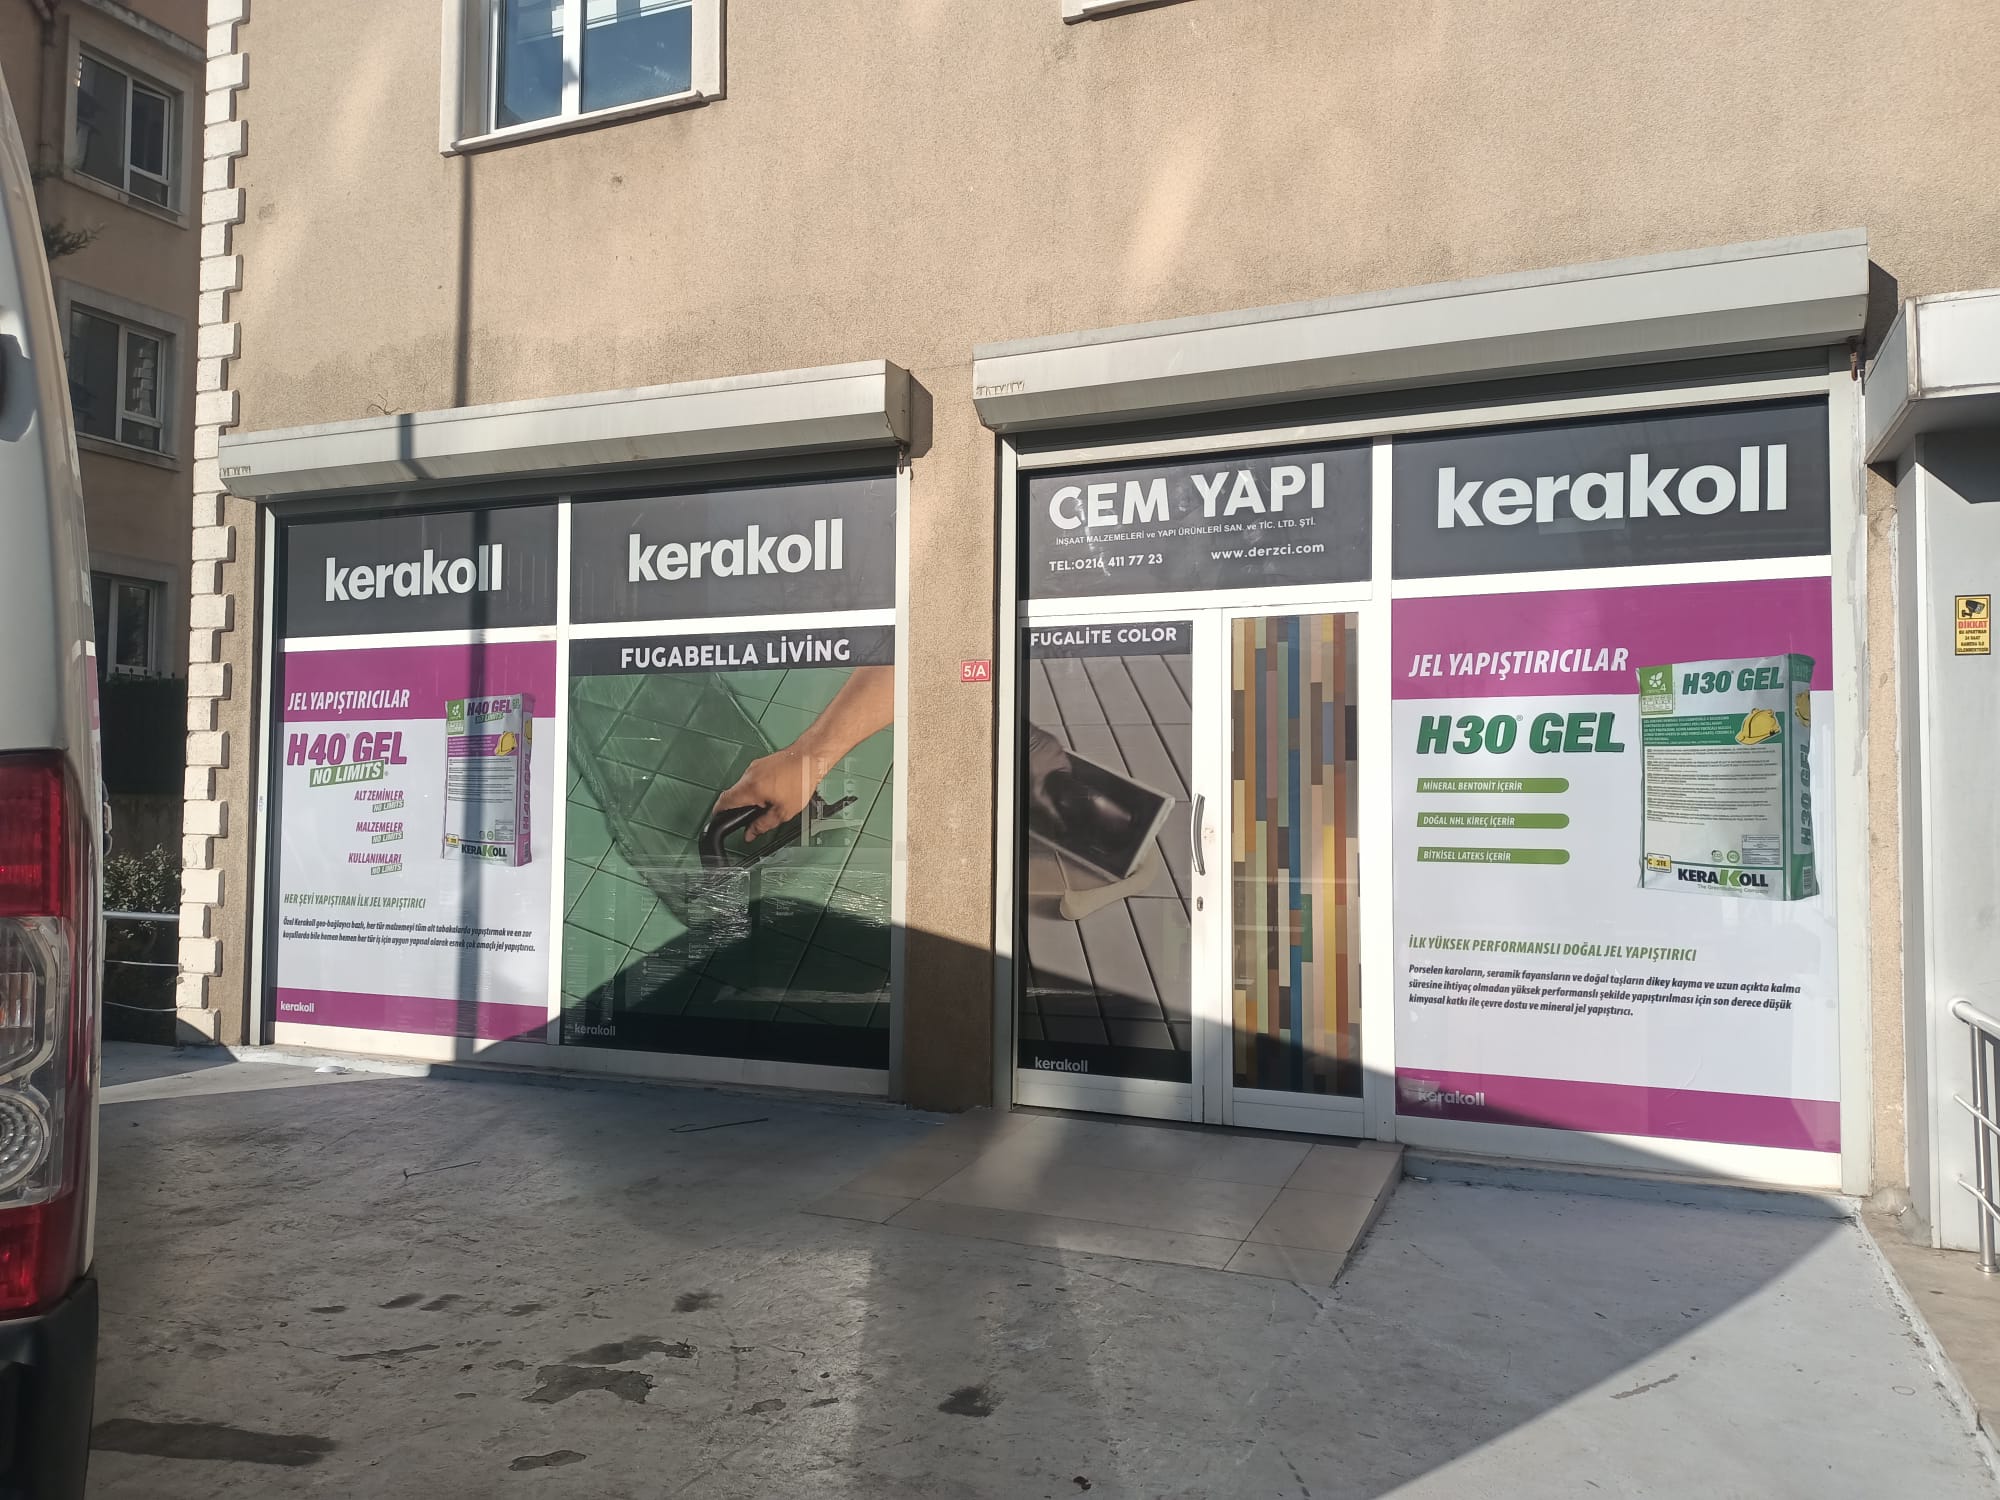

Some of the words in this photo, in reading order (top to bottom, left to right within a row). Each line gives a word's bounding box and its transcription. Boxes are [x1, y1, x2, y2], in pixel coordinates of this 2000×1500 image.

[1437, 443, 1787, 529] kerakoll
[1048, 478, 1170, 530] CEM
[1190, 462, 1325, 518] YAPI
[1056, 536, 1084, 546] İNŞAAT
[1086, 530, 1145, 543] MALZEMELERİ
[1157, 529, 1176, 538] YAPI
[1178, 524, 1222, 536] ÜRÜNLERİ
[1260, 520, 1276, 529] TİC.
[1277, 519, 1297, 528] LTD.
[1299, 516, 1316, 528] ŞTİ.
[628, 518, 843, 582] kerakoll
[1211, 543, 1325, 560] www.derzci.com
[1108, 556, 1125, 567] 411
[1128, 555, 1144, 566] 77
[1148, 553, 1163, 565] 23
[325, 543, 503, 602] kerakoll
[1030, 627, 1112, 647] FUGALİTE
[1117, 627, 1177, 643] COLOR
[621, 643, 759, 669] FUGABELLA
[767, 635, 850, 664] LİVİNG
[964, 665, 986, 678] 5/A
[1408, 654, 1443, 678] JEL
[1449, 647, 1629, 681] YAPIŞTIRICILAR
[1682, 670, 1732, 695] H30
[1737, 666, 1785, 691] GEL
[288, 692, 308, 711] JEL
[310, 689, 410, 714] YAPIŞTIRICILAR
[491, 699, 512, 713] GEL
[1416, 714, 1518, 755] H30
[1528, 712, 1625, 754] GEL
[287, 732, 347, 766] H40
[352, 731, 408, 765] GEL
[312, 768, 332, 785] NO
[335, 762, 382, 782] LIMITS
[354, 790, 367, 801] ALT
[367, 787, 404, 801] ZEMİNLER
[1423, 780, 1457, 791] MİNERAL
[1458, 781, 1496, 791] BENTONİT
[1497, 780, 1523, 793] İÇERİR
[356, 821, 404, 833] MALZEMELER
[1423, 815, 1448, 825] DOĞAL
[1449, 816, 1465, 825] NHL
[1466, 815, 1489, 827] KİREÇ
[1490, 815, 1515, 828] İÇERİR
[348, 852, 402, 864] KULLANIMLARI
[461, 844, 507, 857] KERAKOLL
[1423, 850, 1456, 860] BİTKİSEL
[1457, 851, 1485, 860] LATEKS
[1486, 850, 1511, 862] İÇERİR
[1677, 868, 1768, 887] KERAKOLL
[284, 893, 298, 904] HER
[299, 892, 315, 907] ŞEYİ
[315, 894, 356, 908] YAPIŞTIRAN
[357, 893, 371, 906] İLK
[369, 897, 381, 907] JEL
[382, 897, 426, 910] YAPIŞTIRICI
[367, 921, 376, 930] her
[1409, 934, 1427, 949] İLK
[1428, 936, 1471, 951] YÜKSEK
[1472, 939, 1561, 955] PERFORMANSLI
[1563, 942, 1602, 957] DOĞAL
[1604, 945, 1623, 958] JEL
[1625, 946, 1697, 962] YAPIŞTIRICI
[1409, 964, 1443, 975] Porselen
[1444, 965, 1486, 979] karoların,
[1486, 968, 1520, 980] seramik
[1521, 969, 1570, 982] fayansların
[1572, 974, 1583, 982] ve
[1584, 974, 1608, 986] doğal
[1610, 975, 1644, 987] taşların
[1646, 976, 1671, 989] dikey
[1671, 978, 1702, 991] kayma
[1704, 981, 1715, 989] ve
[1716, 982, 1738, 991] uzun
[1740, 983, 1769, 994] açıkta
[1770, 983, 1801, 994] kalma
[1409, 979, 1442, 990] süresine
[1443, 981, 1471, 994] ihtiyaç
[1473, 982, 1510, 994] olmadan
[1511, 985, 1541, 996] yüksek
[1541, 986, 1599, 999] performanslı
[1600, 989, 1631, 1001] şekilde
[1632, 992, 1694, 1005] yapıştırılması
[1695, 994, 1712, 1006] için
[1713, 997, 1730, 1006] son
[1731, 996, 1761, 1008] derece
[1763, 998, 1792, 1011] düşük
[280, 1000, 315, 1013] kerakoll
[1409, 993, 1445, 1005] kimyasal
[1446, 995, 1467, 1006] katkı
[1469, 997, 1480, 1007] ile
[1480, 999, 1503, 1010] çevre
[1504, 999, 1528, 1010] dostu
[1529, 1002, 1539, 1010] ve
[1540, 1001, 1574, 1012] mineral
[1574, 1002, 1586, 1015] jel
[1587, 1005, 1633, 1017] yapıştırıcı.
[574, 1023, 616, 1036] kerakoll
[1034, 1056, 1088, 1073] kerakoll
[1418, 1088, 1485, 1106] kerakoll
